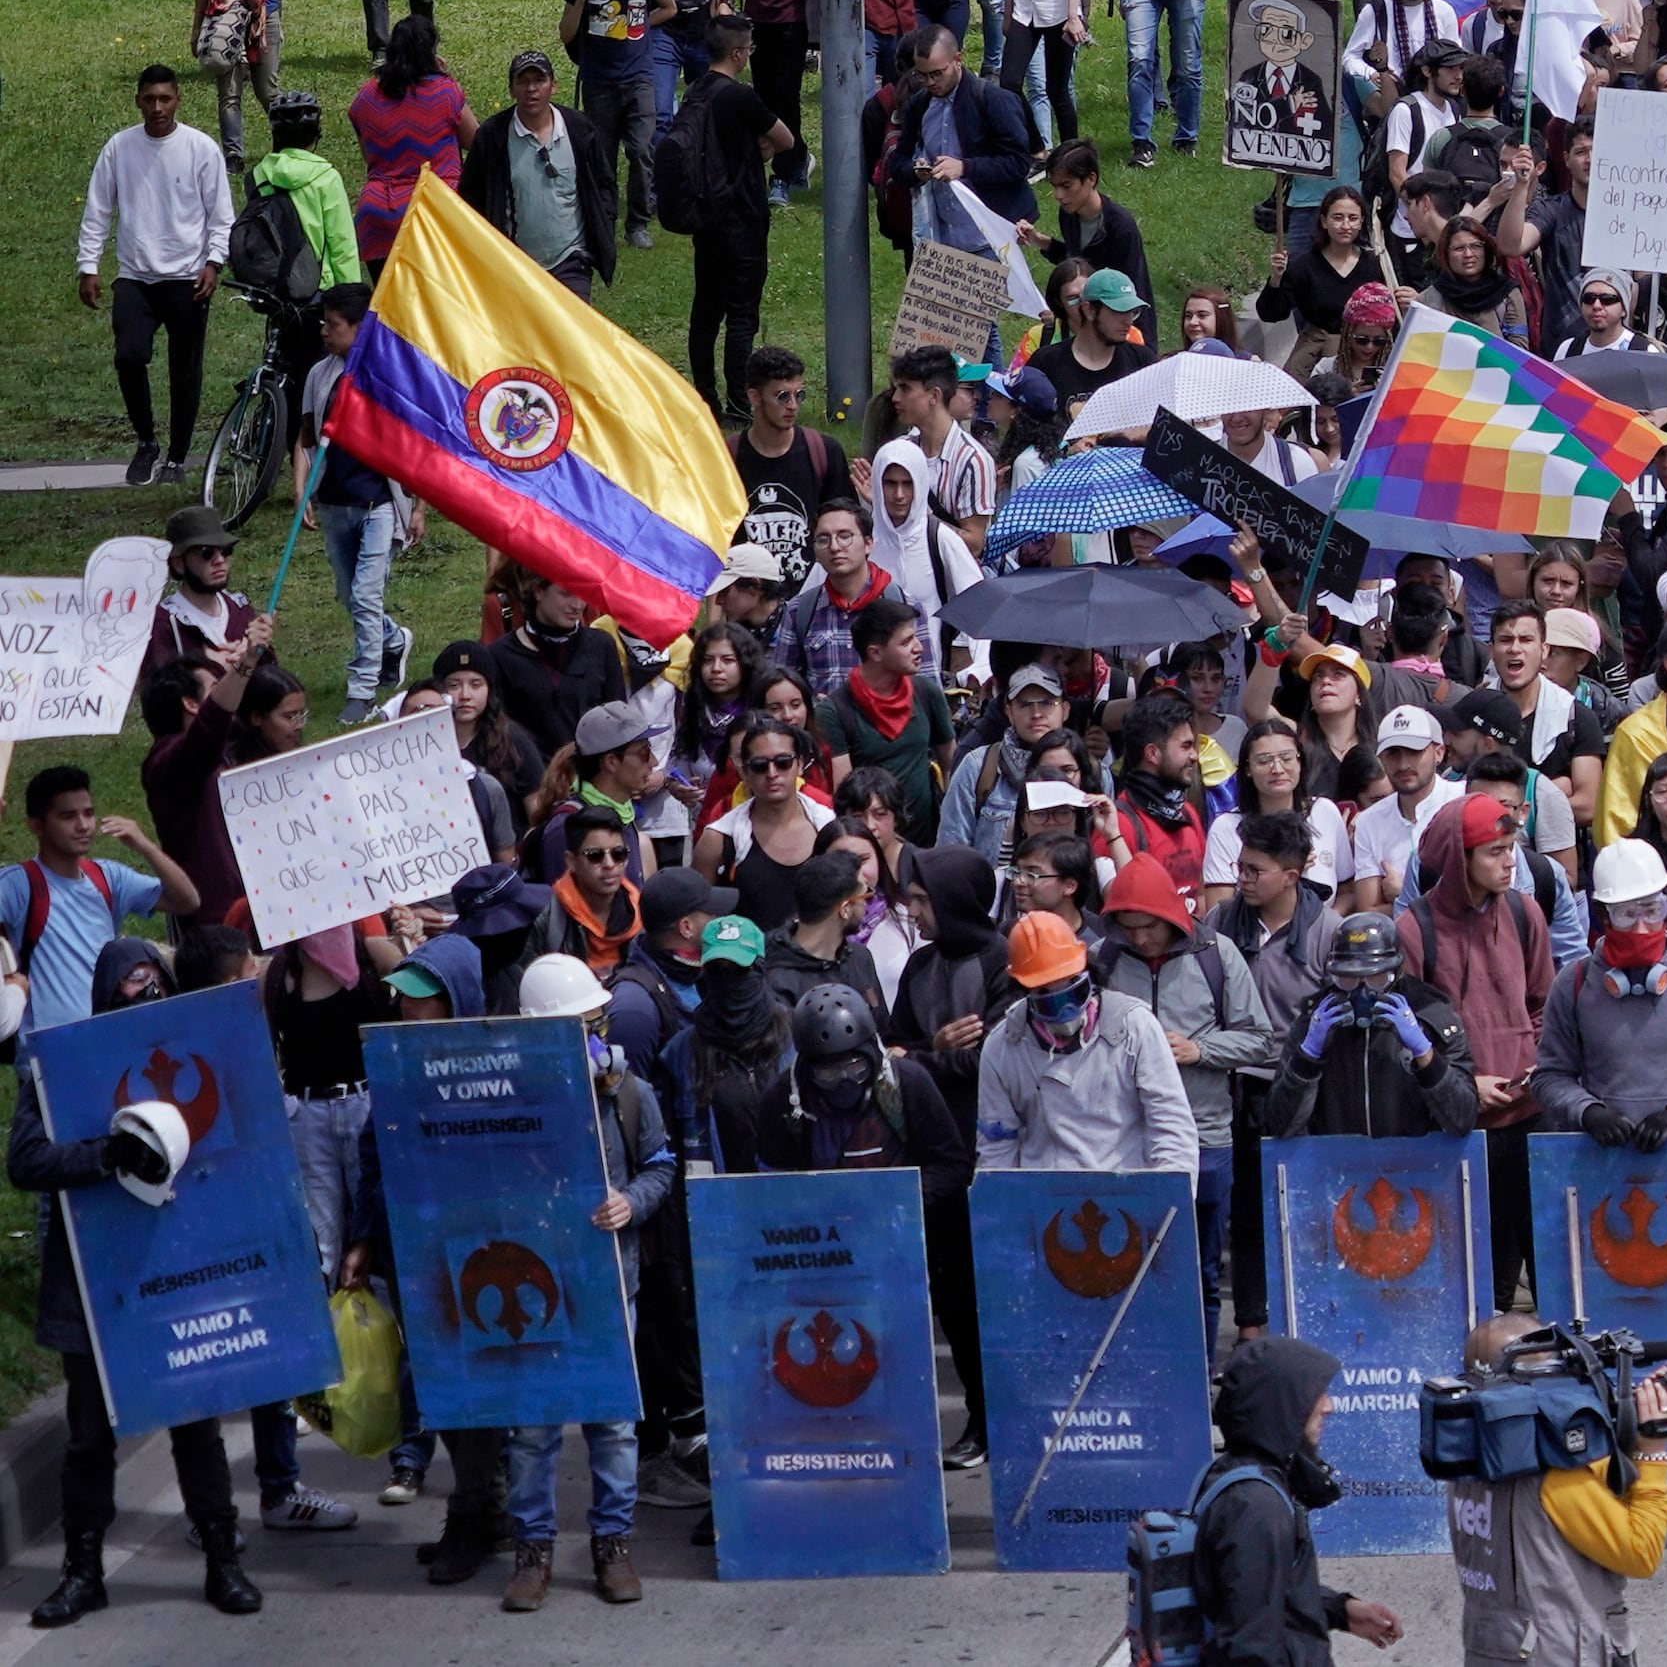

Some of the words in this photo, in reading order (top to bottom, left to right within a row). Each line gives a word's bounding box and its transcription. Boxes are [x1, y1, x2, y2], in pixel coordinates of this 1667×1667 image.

[1234, 100, 1278, 130] NO
[1240, 132, 1328, 166] VENENO
[1603, 186, 1624, 207] del
[1609, 215, 1627, 234] de
[944, 255, 954, 265] no
[473, 437, 555, 472] COLOMBIA
[1200, 455, 1273, 516] MARICAS
[55, 593, 84, 615] LA
[43, 666, 90, 688] QUE
[38, 690, 103, 720] ESTÁN
[224, 768, 304, 814] ¿QUÉ
[333, 734, 442, 782] COSECHA
[277, 816, 316, 847] UN
[360, 784, 408, 821] PAÍS
[279, 858, 326, 892] QUE
[352, 827, 442, 868] SIEMBRA
[363, 836, 487, 900] MUERTOS?
[437, 1081, 452, 1101] A
[458, 1079, 515, 1101] VAMO
[763, 1227, 821, 1248] VAMO
[827, 1226, 840, 1245] A
[754, 1246, 852, 1272] MARCHAR
[140, 1255, 267, 1298] RESISTENCIA
[171, 1311, 233, 1340] VAMO
[236, 1307, 252, 1325] A
[167, 1330, 267, 1369] MARCHAR
[1344, 1367, 1403, 1385] VAMO
[1407, 1367, 1421, 1383] A
[1052, 1411, 1112, 1429] VAMO
[1117, 1411, 1131, 1427] A
[1044, 1435, 1142, 1453] MARCHAR
[765, 1452, 893, 1471] RESISTENCIA
